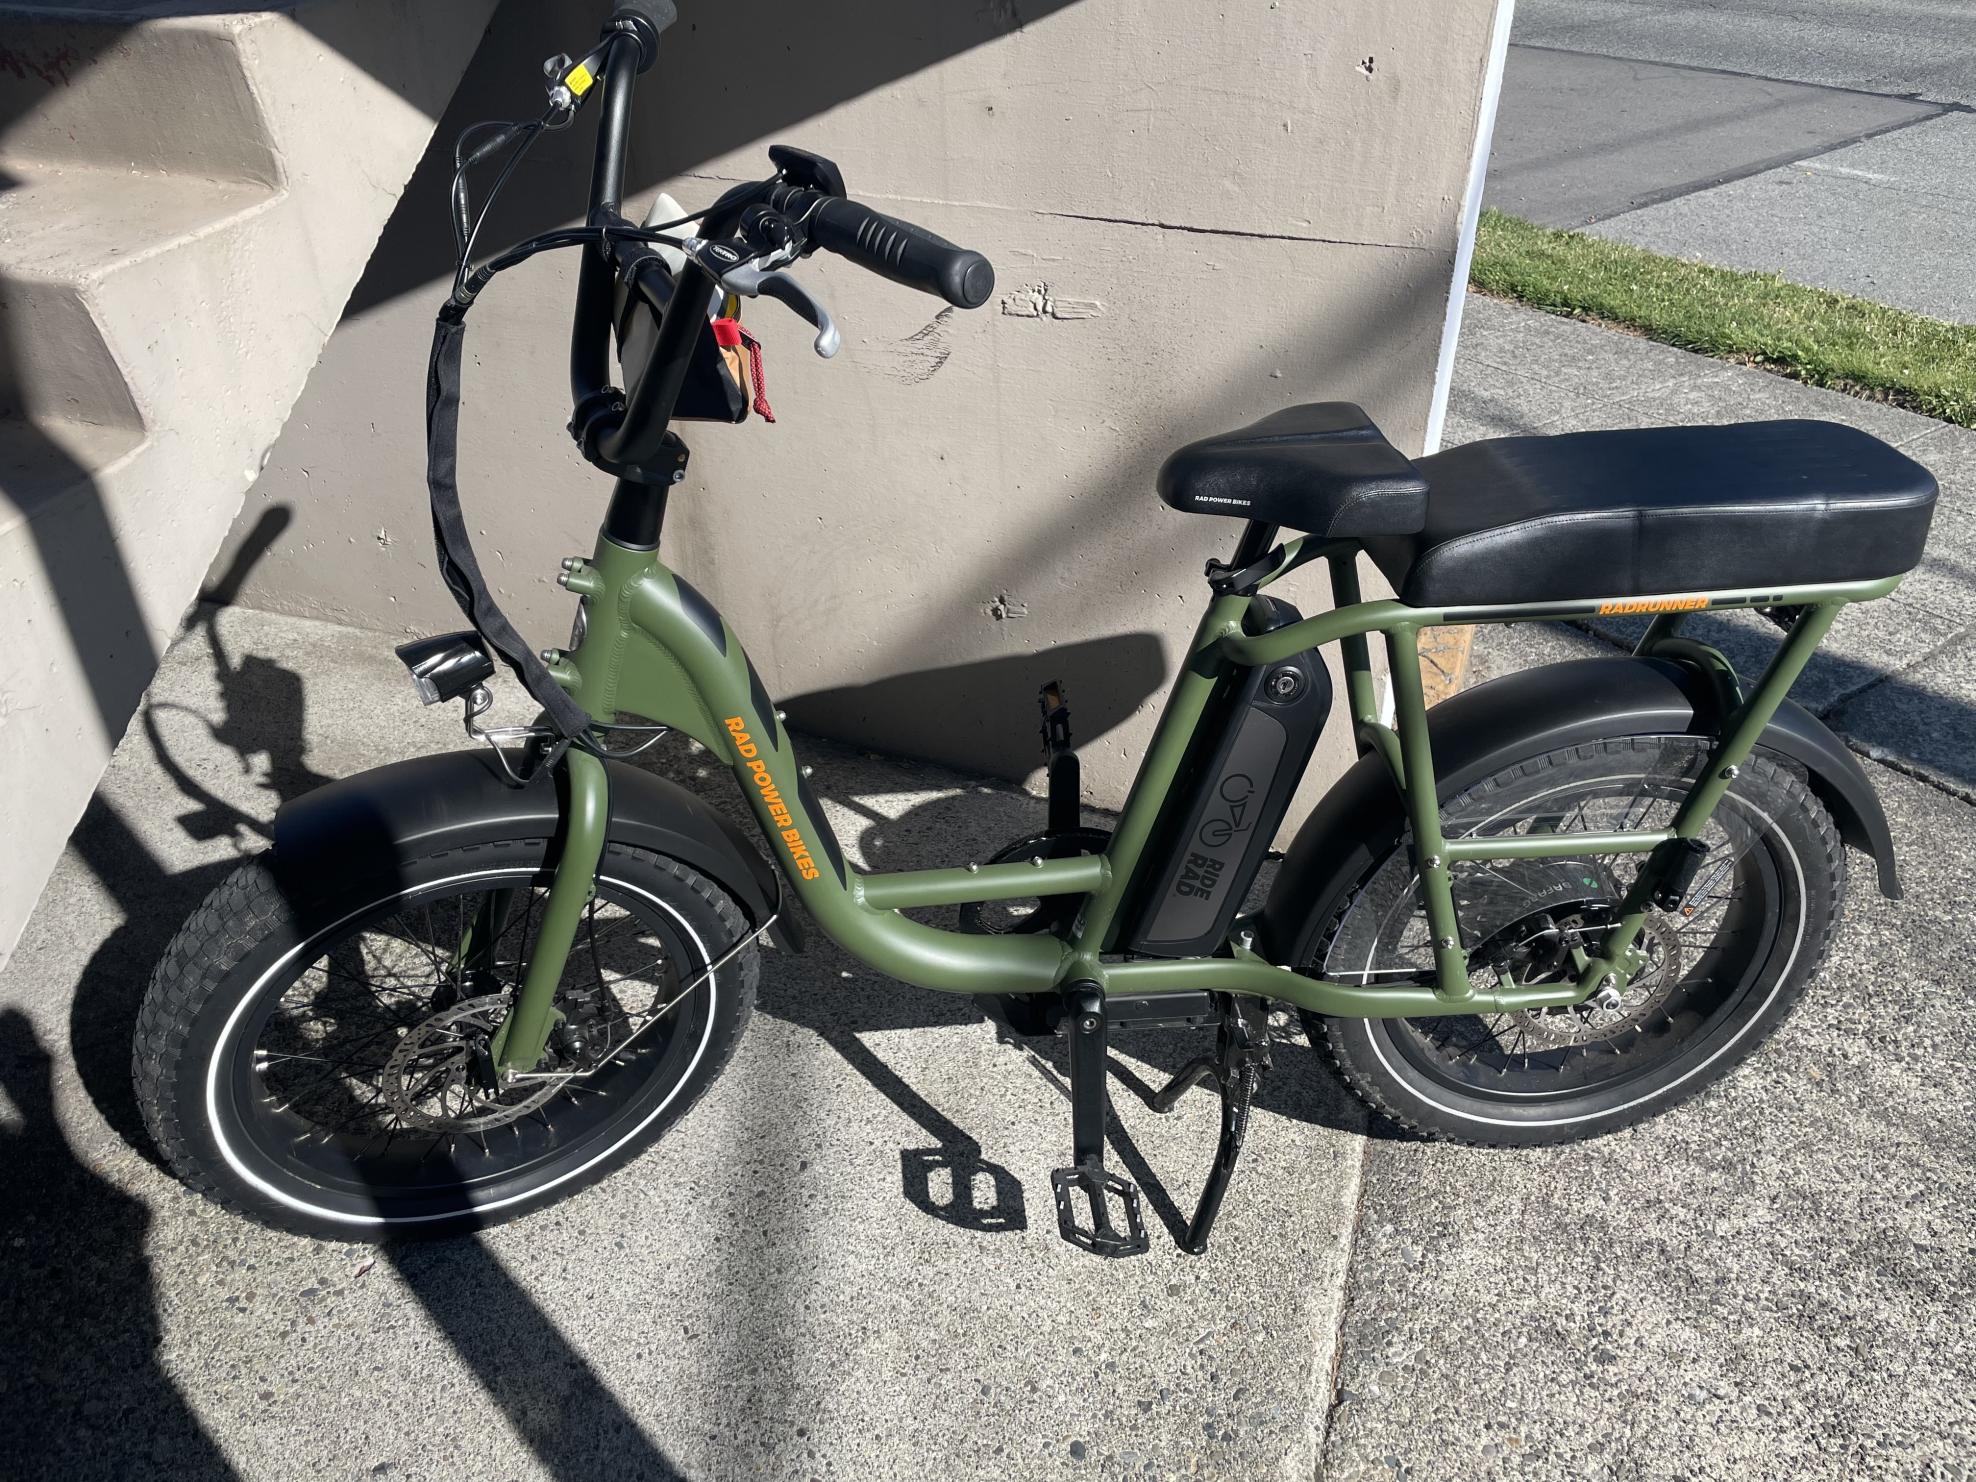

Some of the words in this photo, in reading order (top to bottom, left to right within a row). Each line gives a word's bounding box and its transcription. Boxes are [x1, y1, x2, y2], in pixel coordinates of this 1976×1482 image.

[1599, 597, 1709, 615] RADRUNNER
[723, 716, 759, 759] RAD
[744, 759, 794, 829] POWER
[781, 828, 821, 881] BIKES
[1175, 852, 1209, 897] RAD
[1193, 857, 1225, 901] RIDE
